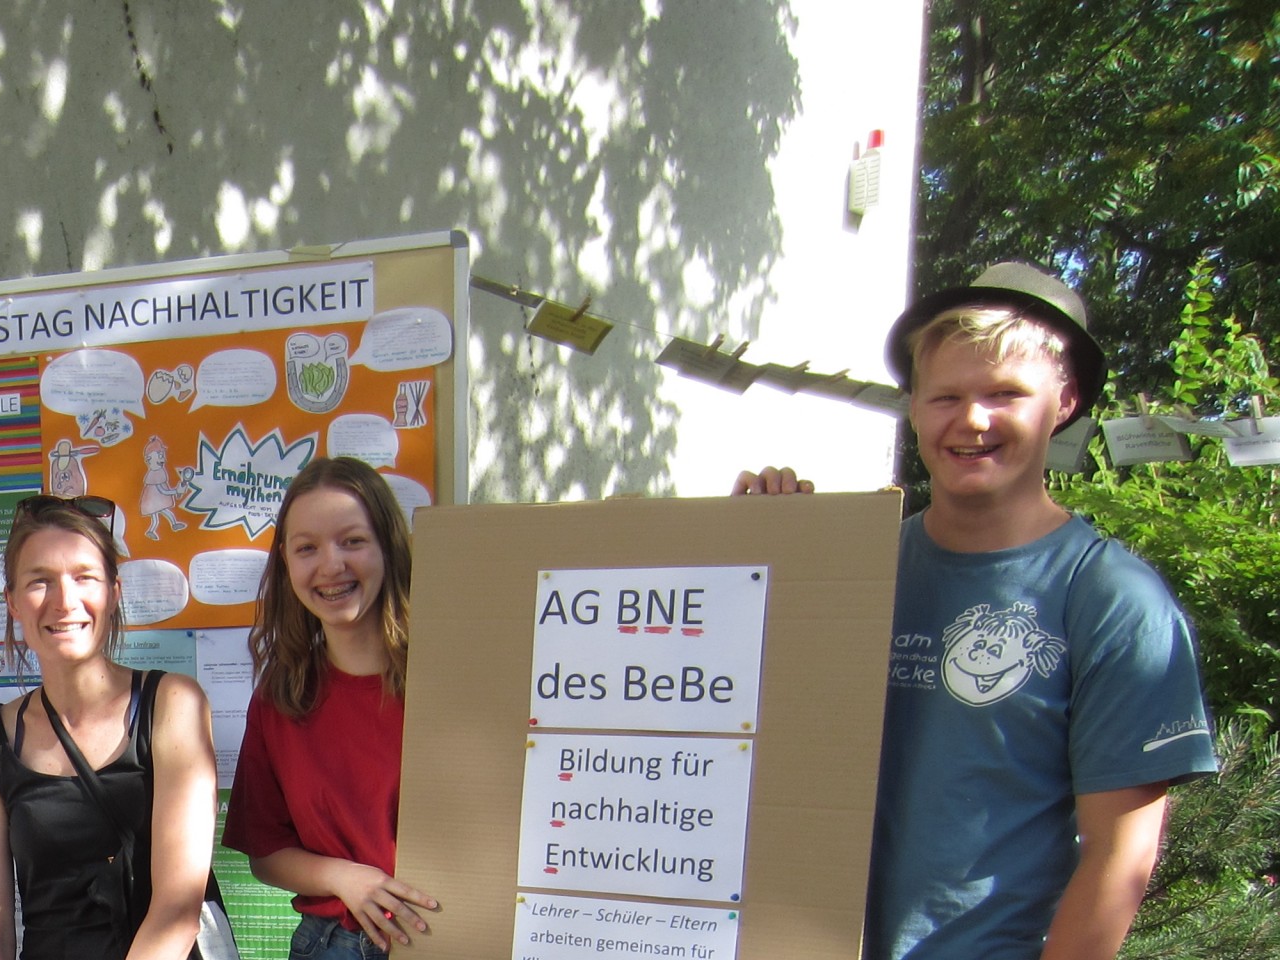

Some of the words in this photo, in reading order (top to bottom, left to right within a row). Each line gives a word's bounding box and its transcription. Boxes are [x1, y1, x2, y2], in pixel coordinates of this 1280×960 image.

[84, 278, 370, 331] NACHHALTIGKEIT
[226, 484, 281, 507] mythen
[538, 589, 600, 625] AG
[617, 588, 705, 625] BNE
[895, 633, 932, 648] am
[891, 652, 938, 663] gendhaus
[891, 663, 935, 683] icke
[537, 662, 607, 701] des
[623, 665, 734, 704] BeBe
[560, 748, 663, 781] Bildung
[671, 751, 714, 777] für
[551, 797, 714, 832] nachhaltige
[546, 843, 714, 883] Entwicklung
[531, 903, 580, 919] Lehrer
[596, 908, 652, 926] Schüler
[670, 915, 718, 932] Eltern
[530, 929, 592, 948] arbeiten
[596, 937, 686, 958] gemeinsam
[691, 944, 715, 960] für
